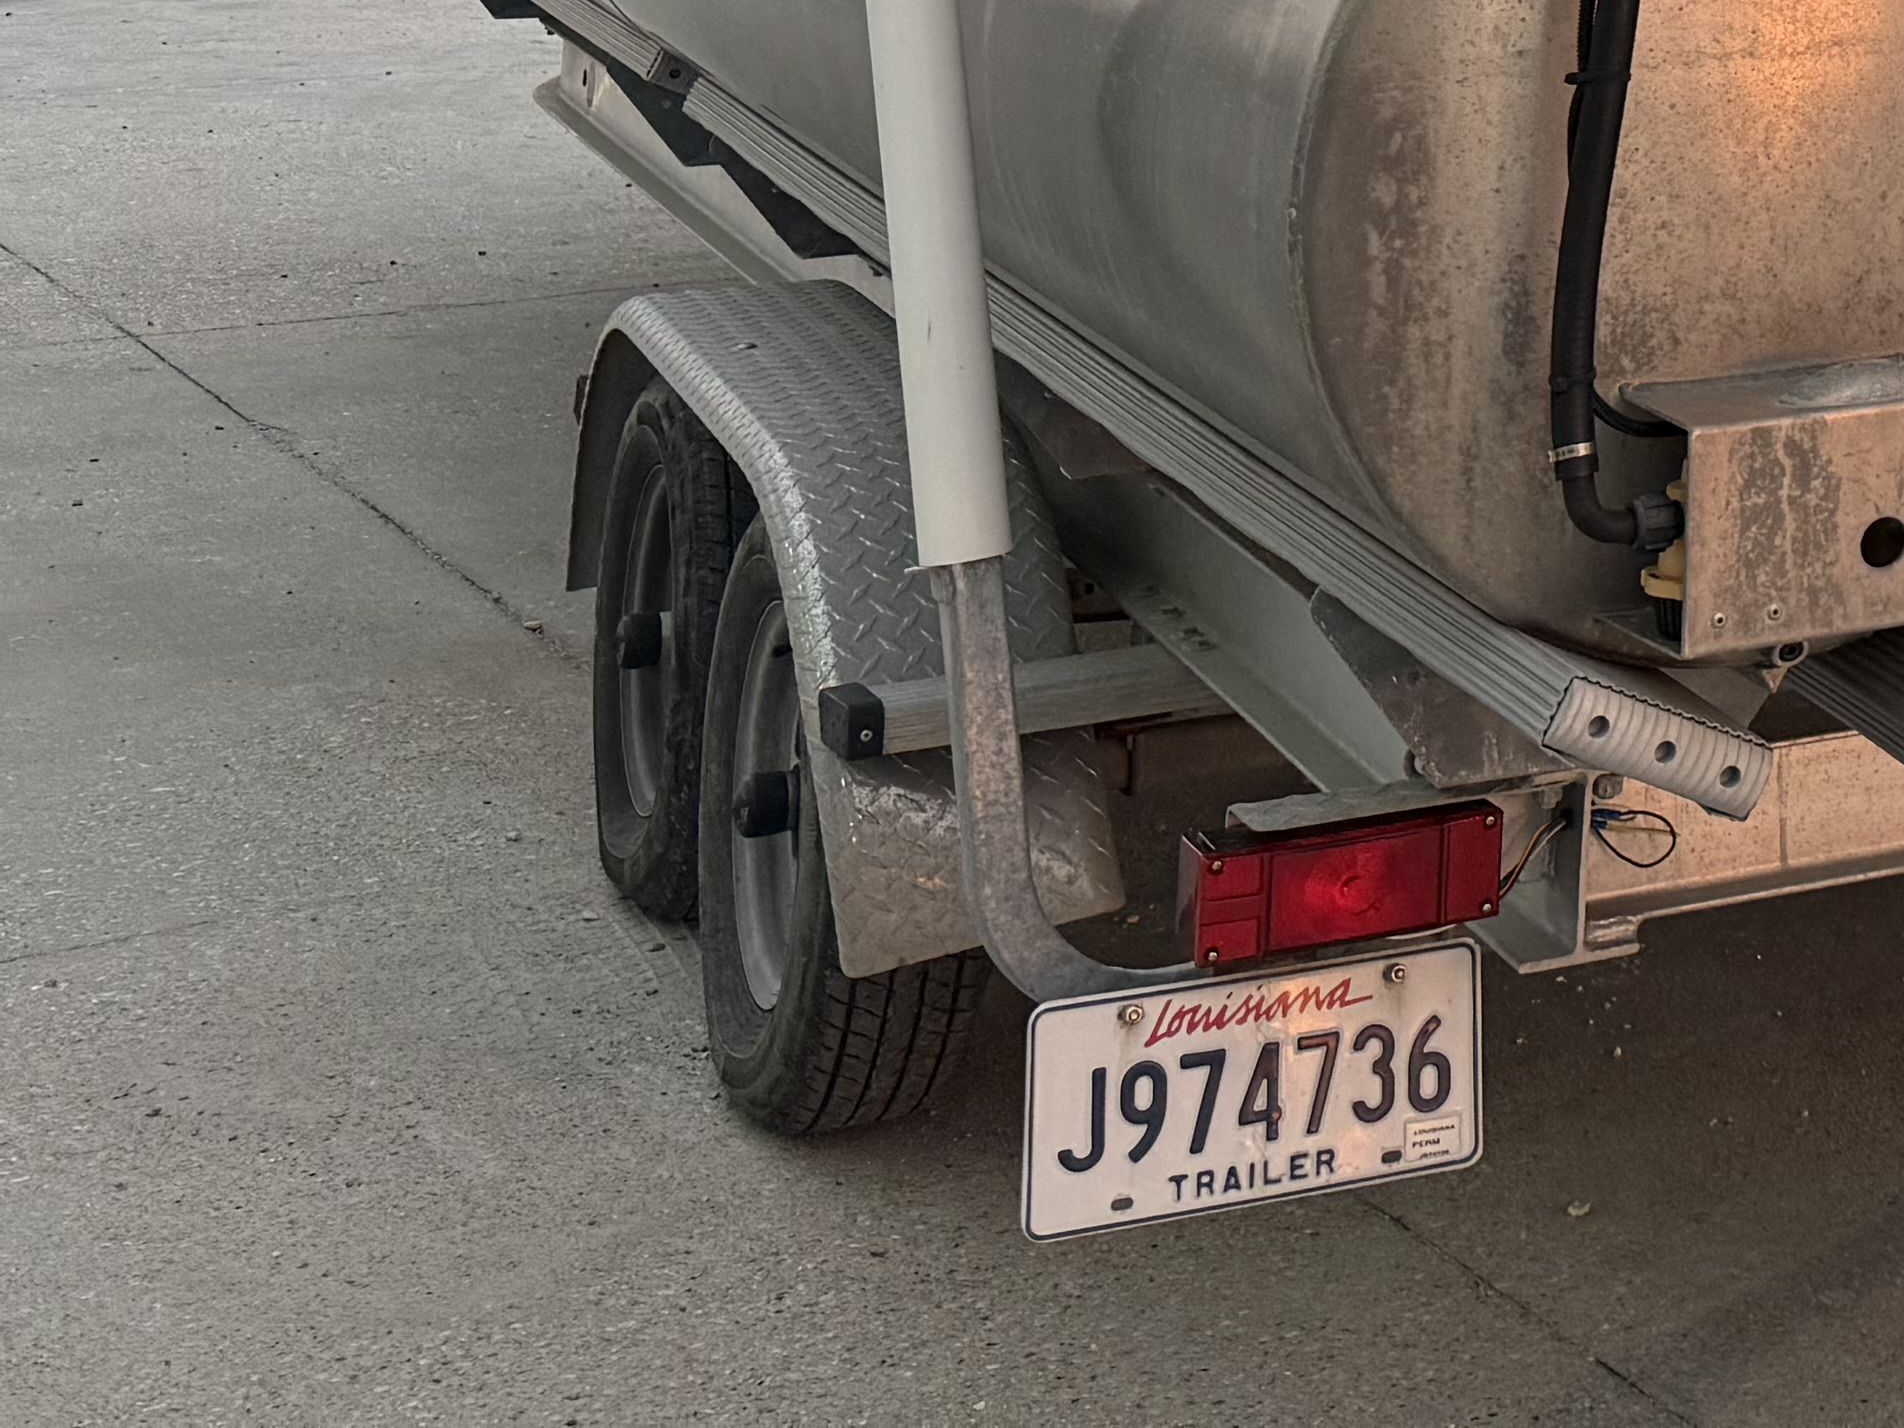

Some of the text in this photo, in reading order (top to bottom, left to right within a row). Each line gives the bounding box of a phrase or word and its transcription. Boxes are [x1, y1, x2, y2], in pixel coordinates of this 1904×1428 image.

[1144, 978, 1373, 1048] Louisiana
[1057, 1014, 1452, 1173] J974736
[1168, 1147, 1338, 1203] TRAILER
